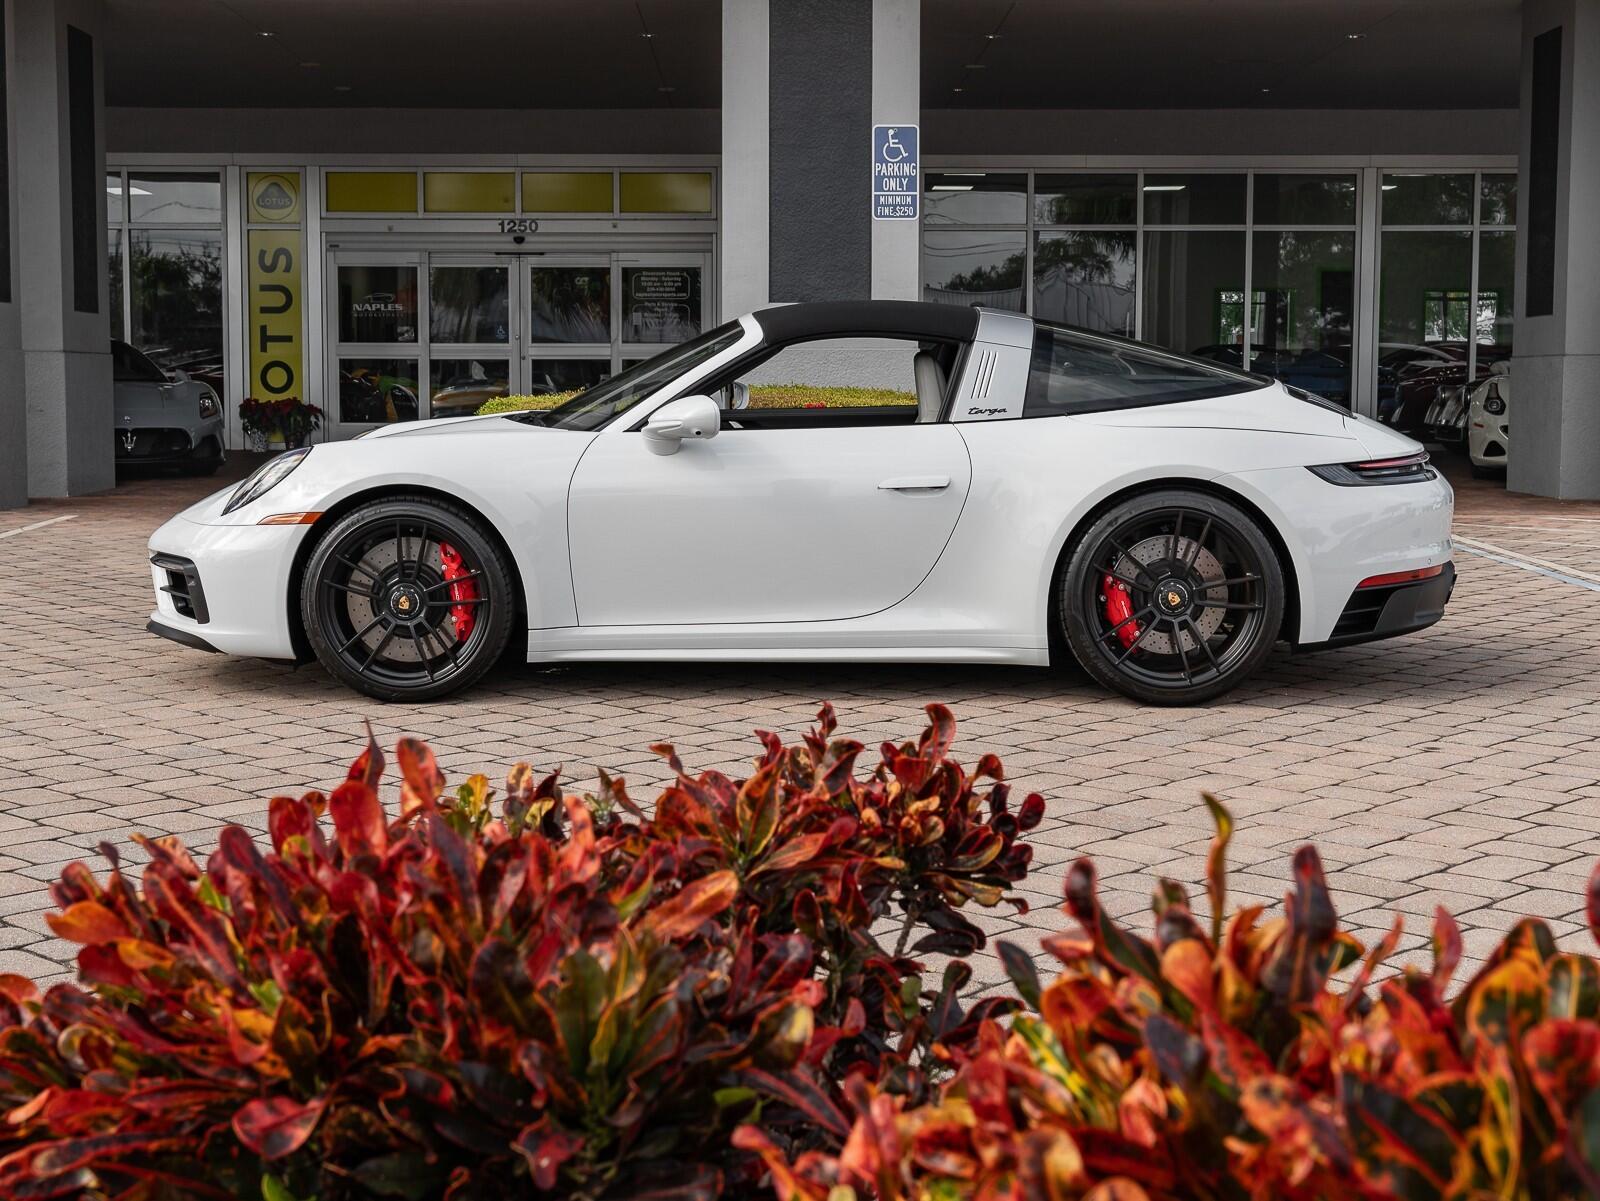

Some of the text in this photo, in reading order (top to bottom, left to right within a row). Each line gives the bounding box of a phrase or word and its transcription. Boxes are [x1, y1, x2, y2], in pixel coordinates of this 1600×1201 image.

[875, 162, 917, 176] PARKING
[882, 177, 909, 191] ONLY
[259, 198, 291, 206] LOTUS
[879, 195, 912, 205] MINIMUM
[877, 205, 914, 216] FINE $250
[498, 219, 539, 233] 1250
[352, 303, 404, 311] NAPLES
[258, 247, 294, 395] OTUS
[967, 406, 1008, 416] targa
